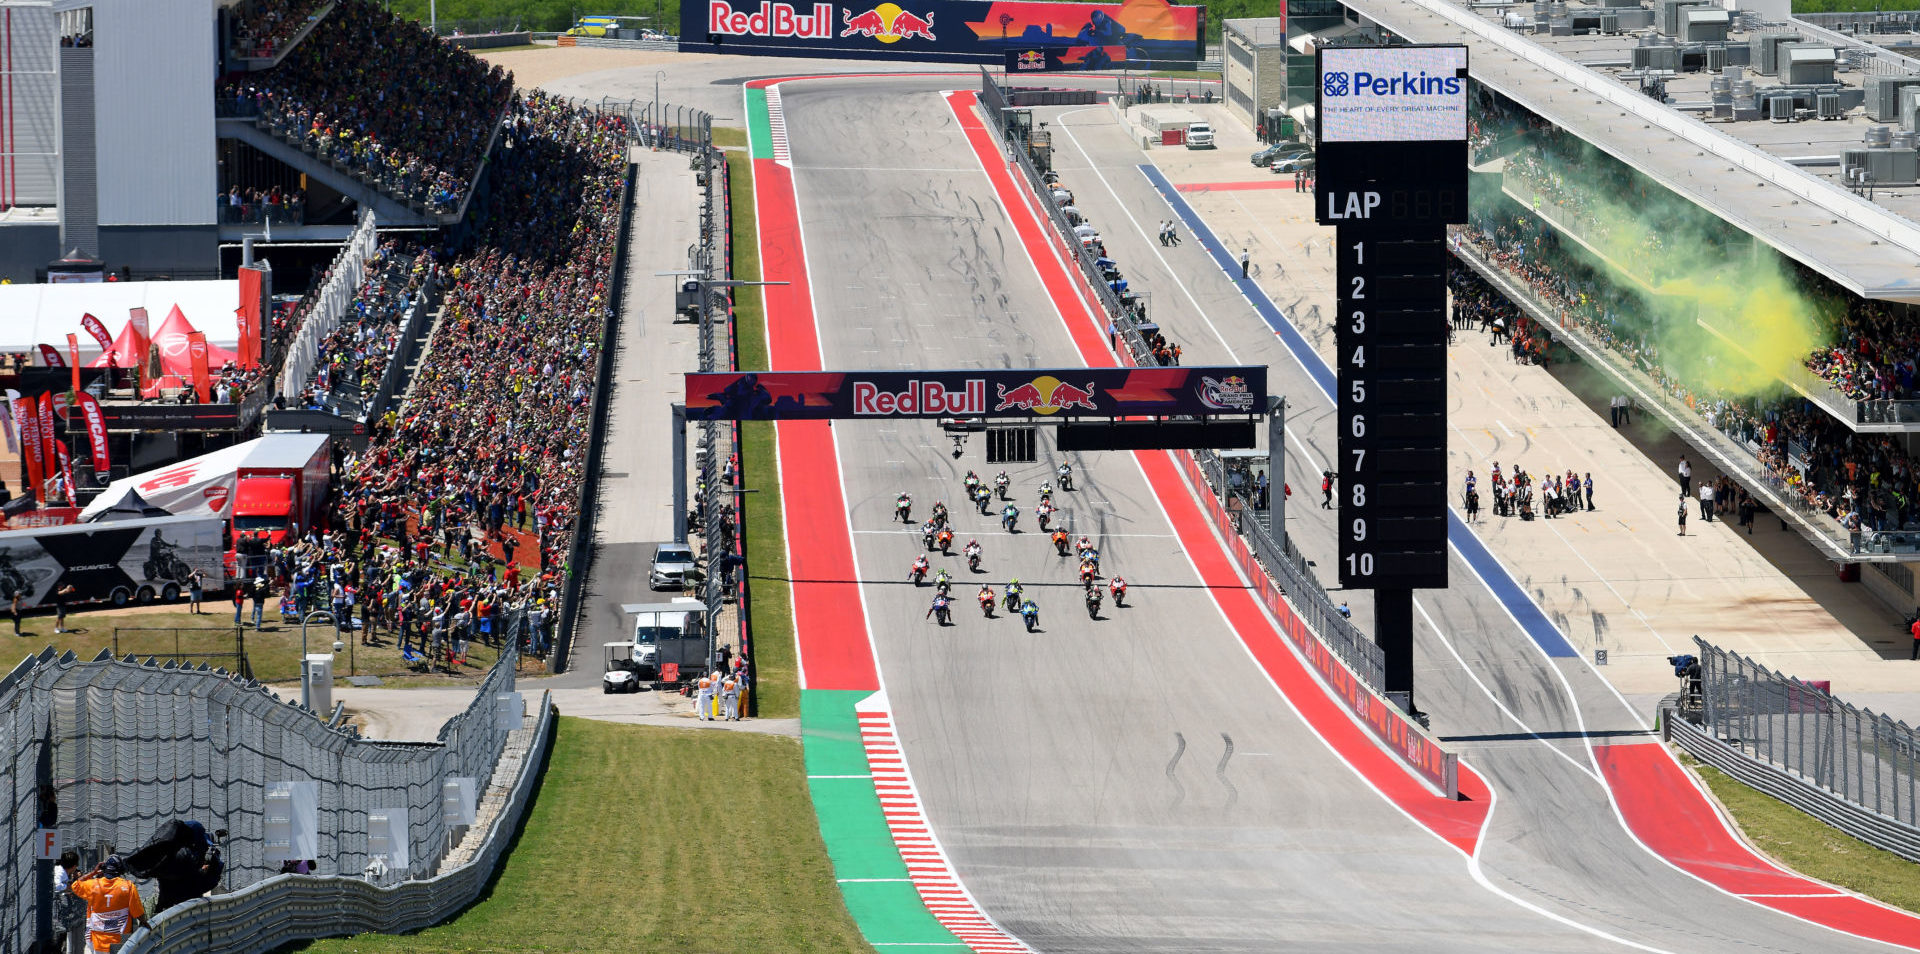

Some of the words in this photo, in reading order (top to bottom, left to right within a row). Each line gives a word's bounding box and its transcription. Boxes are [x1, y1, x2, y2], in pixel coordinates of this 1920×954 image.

[709, 0, 771, 36] Red
[772, 2, 833, 38] Bull
[1018, 61, 1032, 70] Red
[1032, 61, 1046, 70] Bull
[1354, 71, 1461, 96] Perkins
[1329, 192, 1381, 219] LAP
[1353, 242, 1363, 265] 1
[1352, 277, 1365, 299] 2
[1352, 311, 1365, 334] 3
[1352, 346, 1366, 368] 4
[854, 380, 919, 415] Red
[922, 379, 986, 415] Bull
[1352, 381, 1366, 403] 5
[84, 401, 106, 460] DUCATI
[1352, 415, 1365, 438] 6
[1352, 450, 1366, 472] 7
[1352, 484, 1366, 507] 8
[1353, 519, 1366, 542] 9
[68, 563, 115, 572] XDIAVEL
[1346, 553, 1374, 576] 10
[45, 832, 56, 857] F
[104, 894, 114, 908] T
